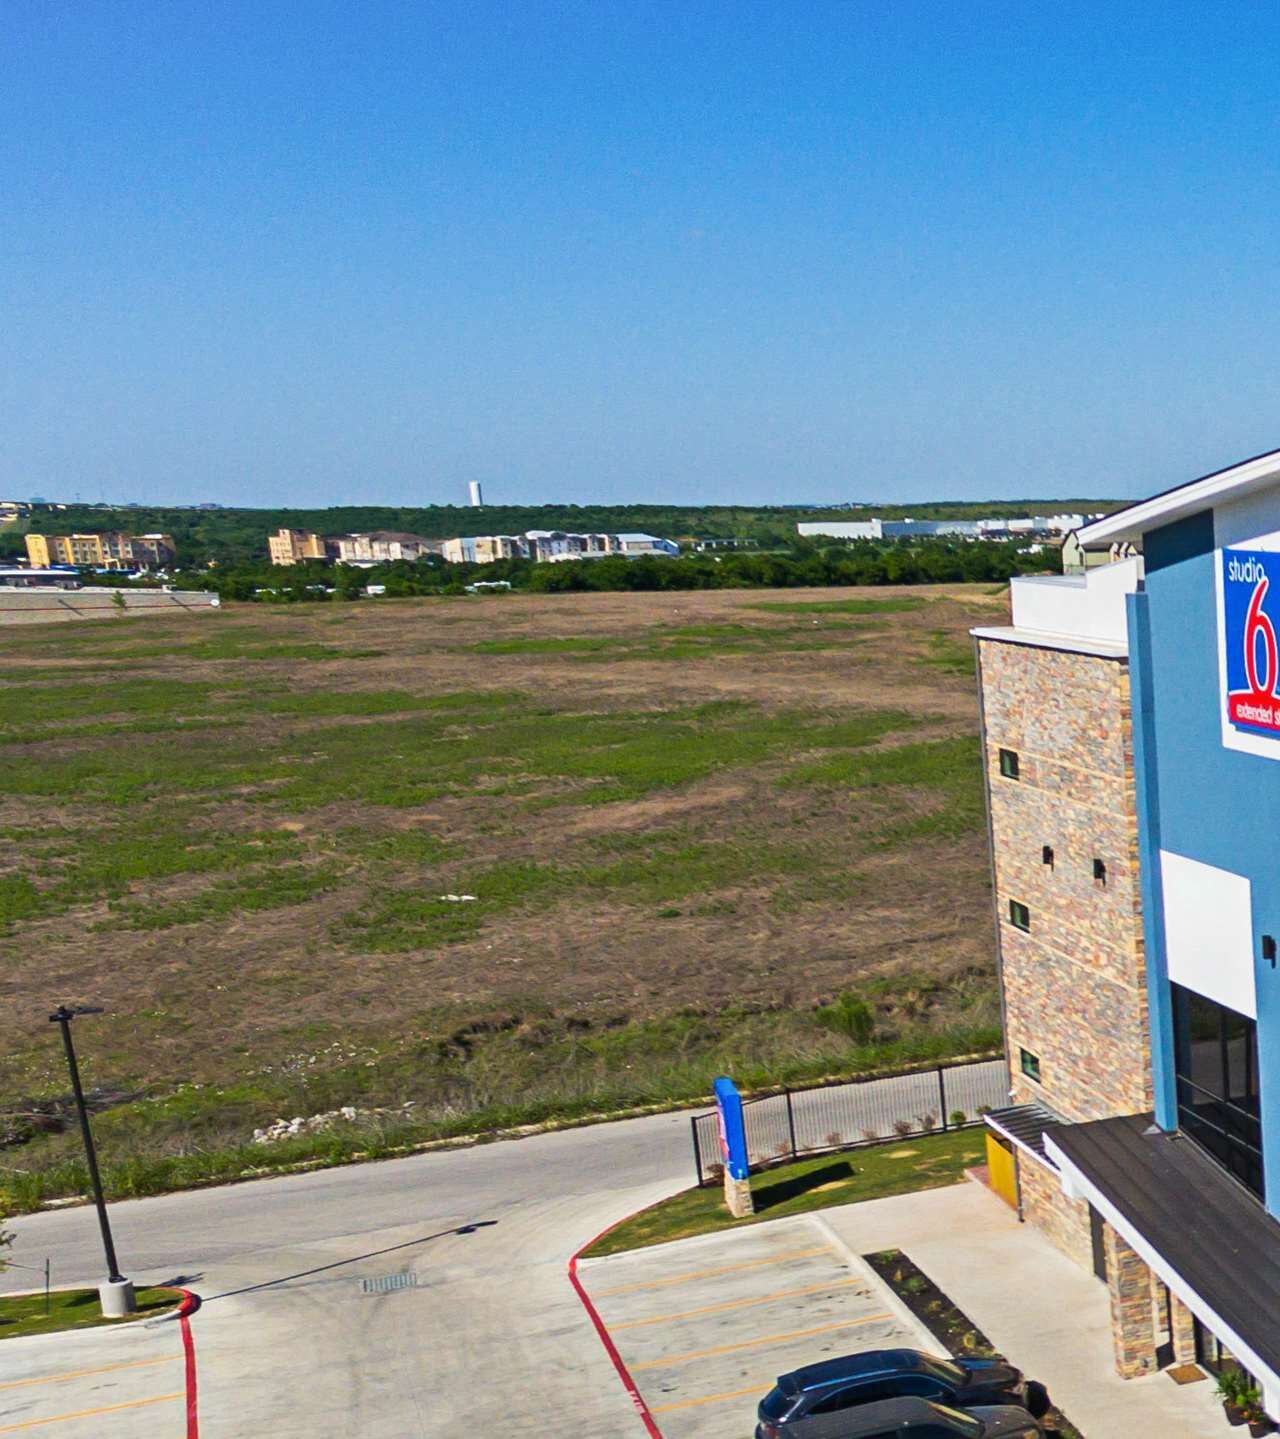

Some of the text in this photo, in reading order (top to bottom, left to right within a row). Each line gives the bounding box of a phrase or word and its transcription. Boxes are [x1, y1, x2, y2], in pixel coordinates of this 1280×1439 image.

[1228, 556, 1266, 583] studio
[1244, 576, 1278, 695] 6
[1236, 702, 1273, 725] extended
